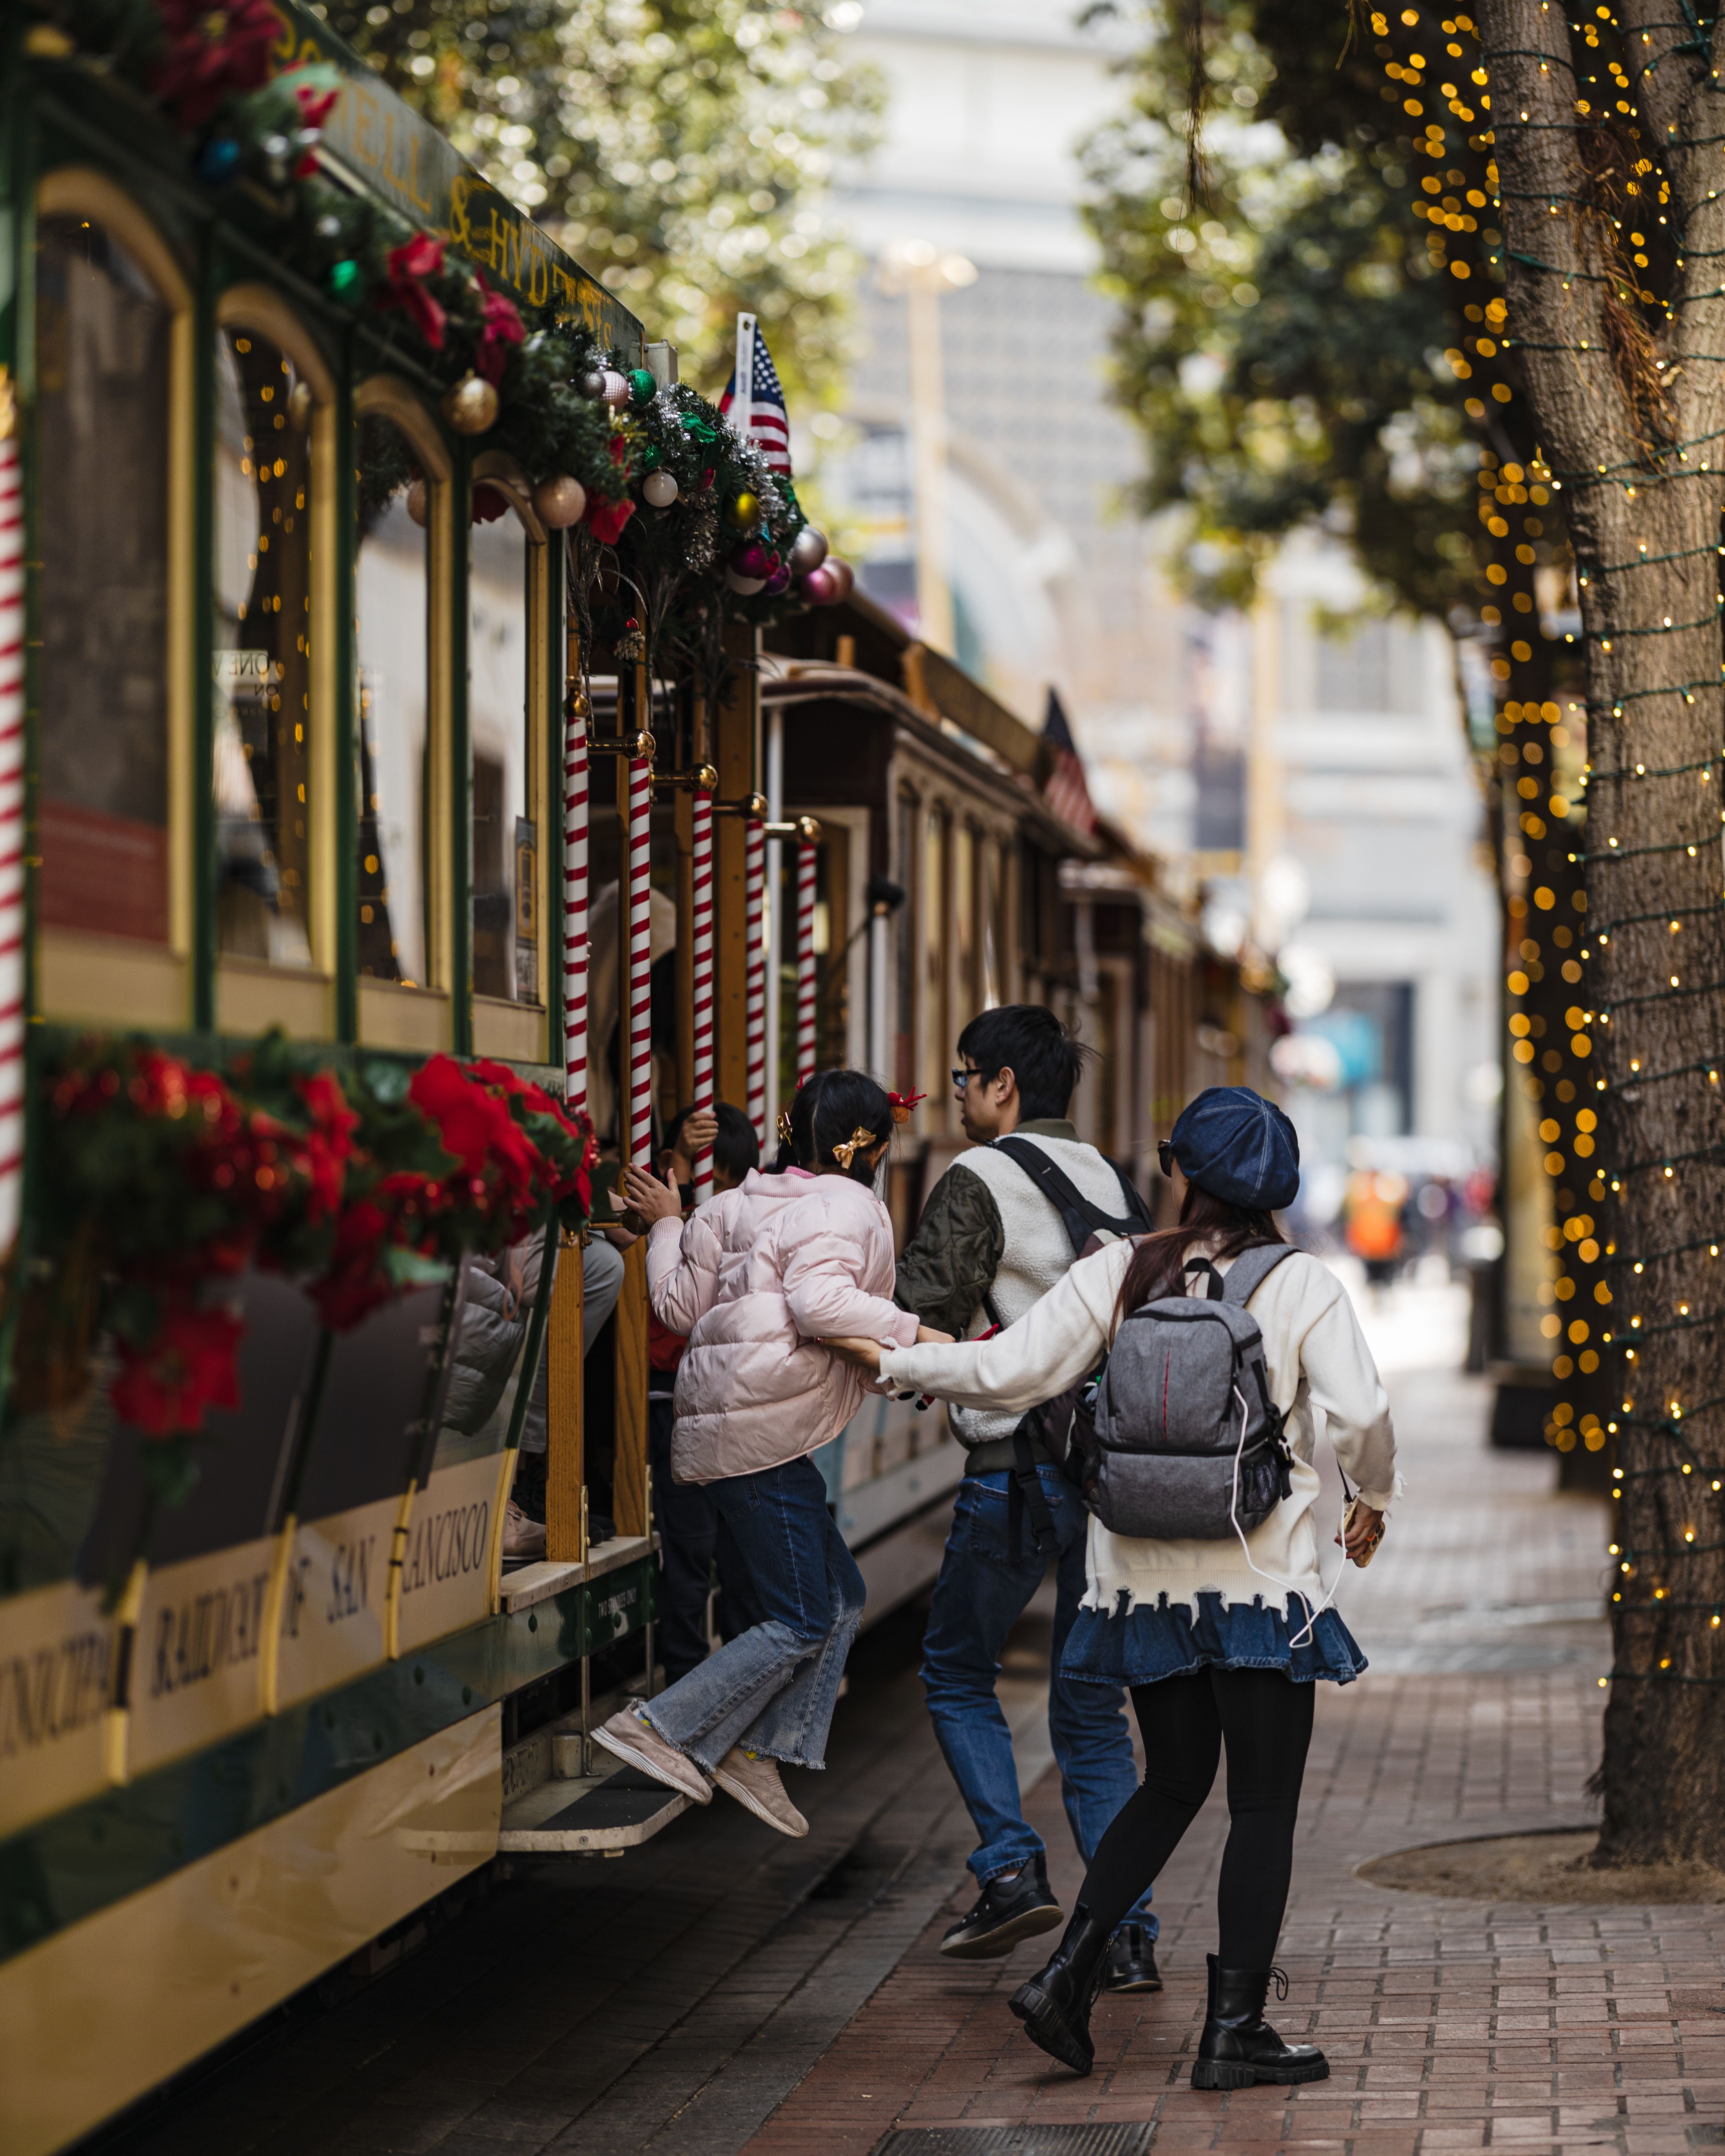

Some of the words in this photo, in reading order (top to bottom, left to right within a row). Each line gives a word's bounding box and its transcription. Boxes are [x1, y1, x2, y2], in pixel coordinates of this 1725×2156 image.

[450, 175, 471, 251] &
[281, 1556, 311, 1638] F
[327, 1533, 376, 1625] SAN
[401, 1500, 488, 1594] RANCISCO
